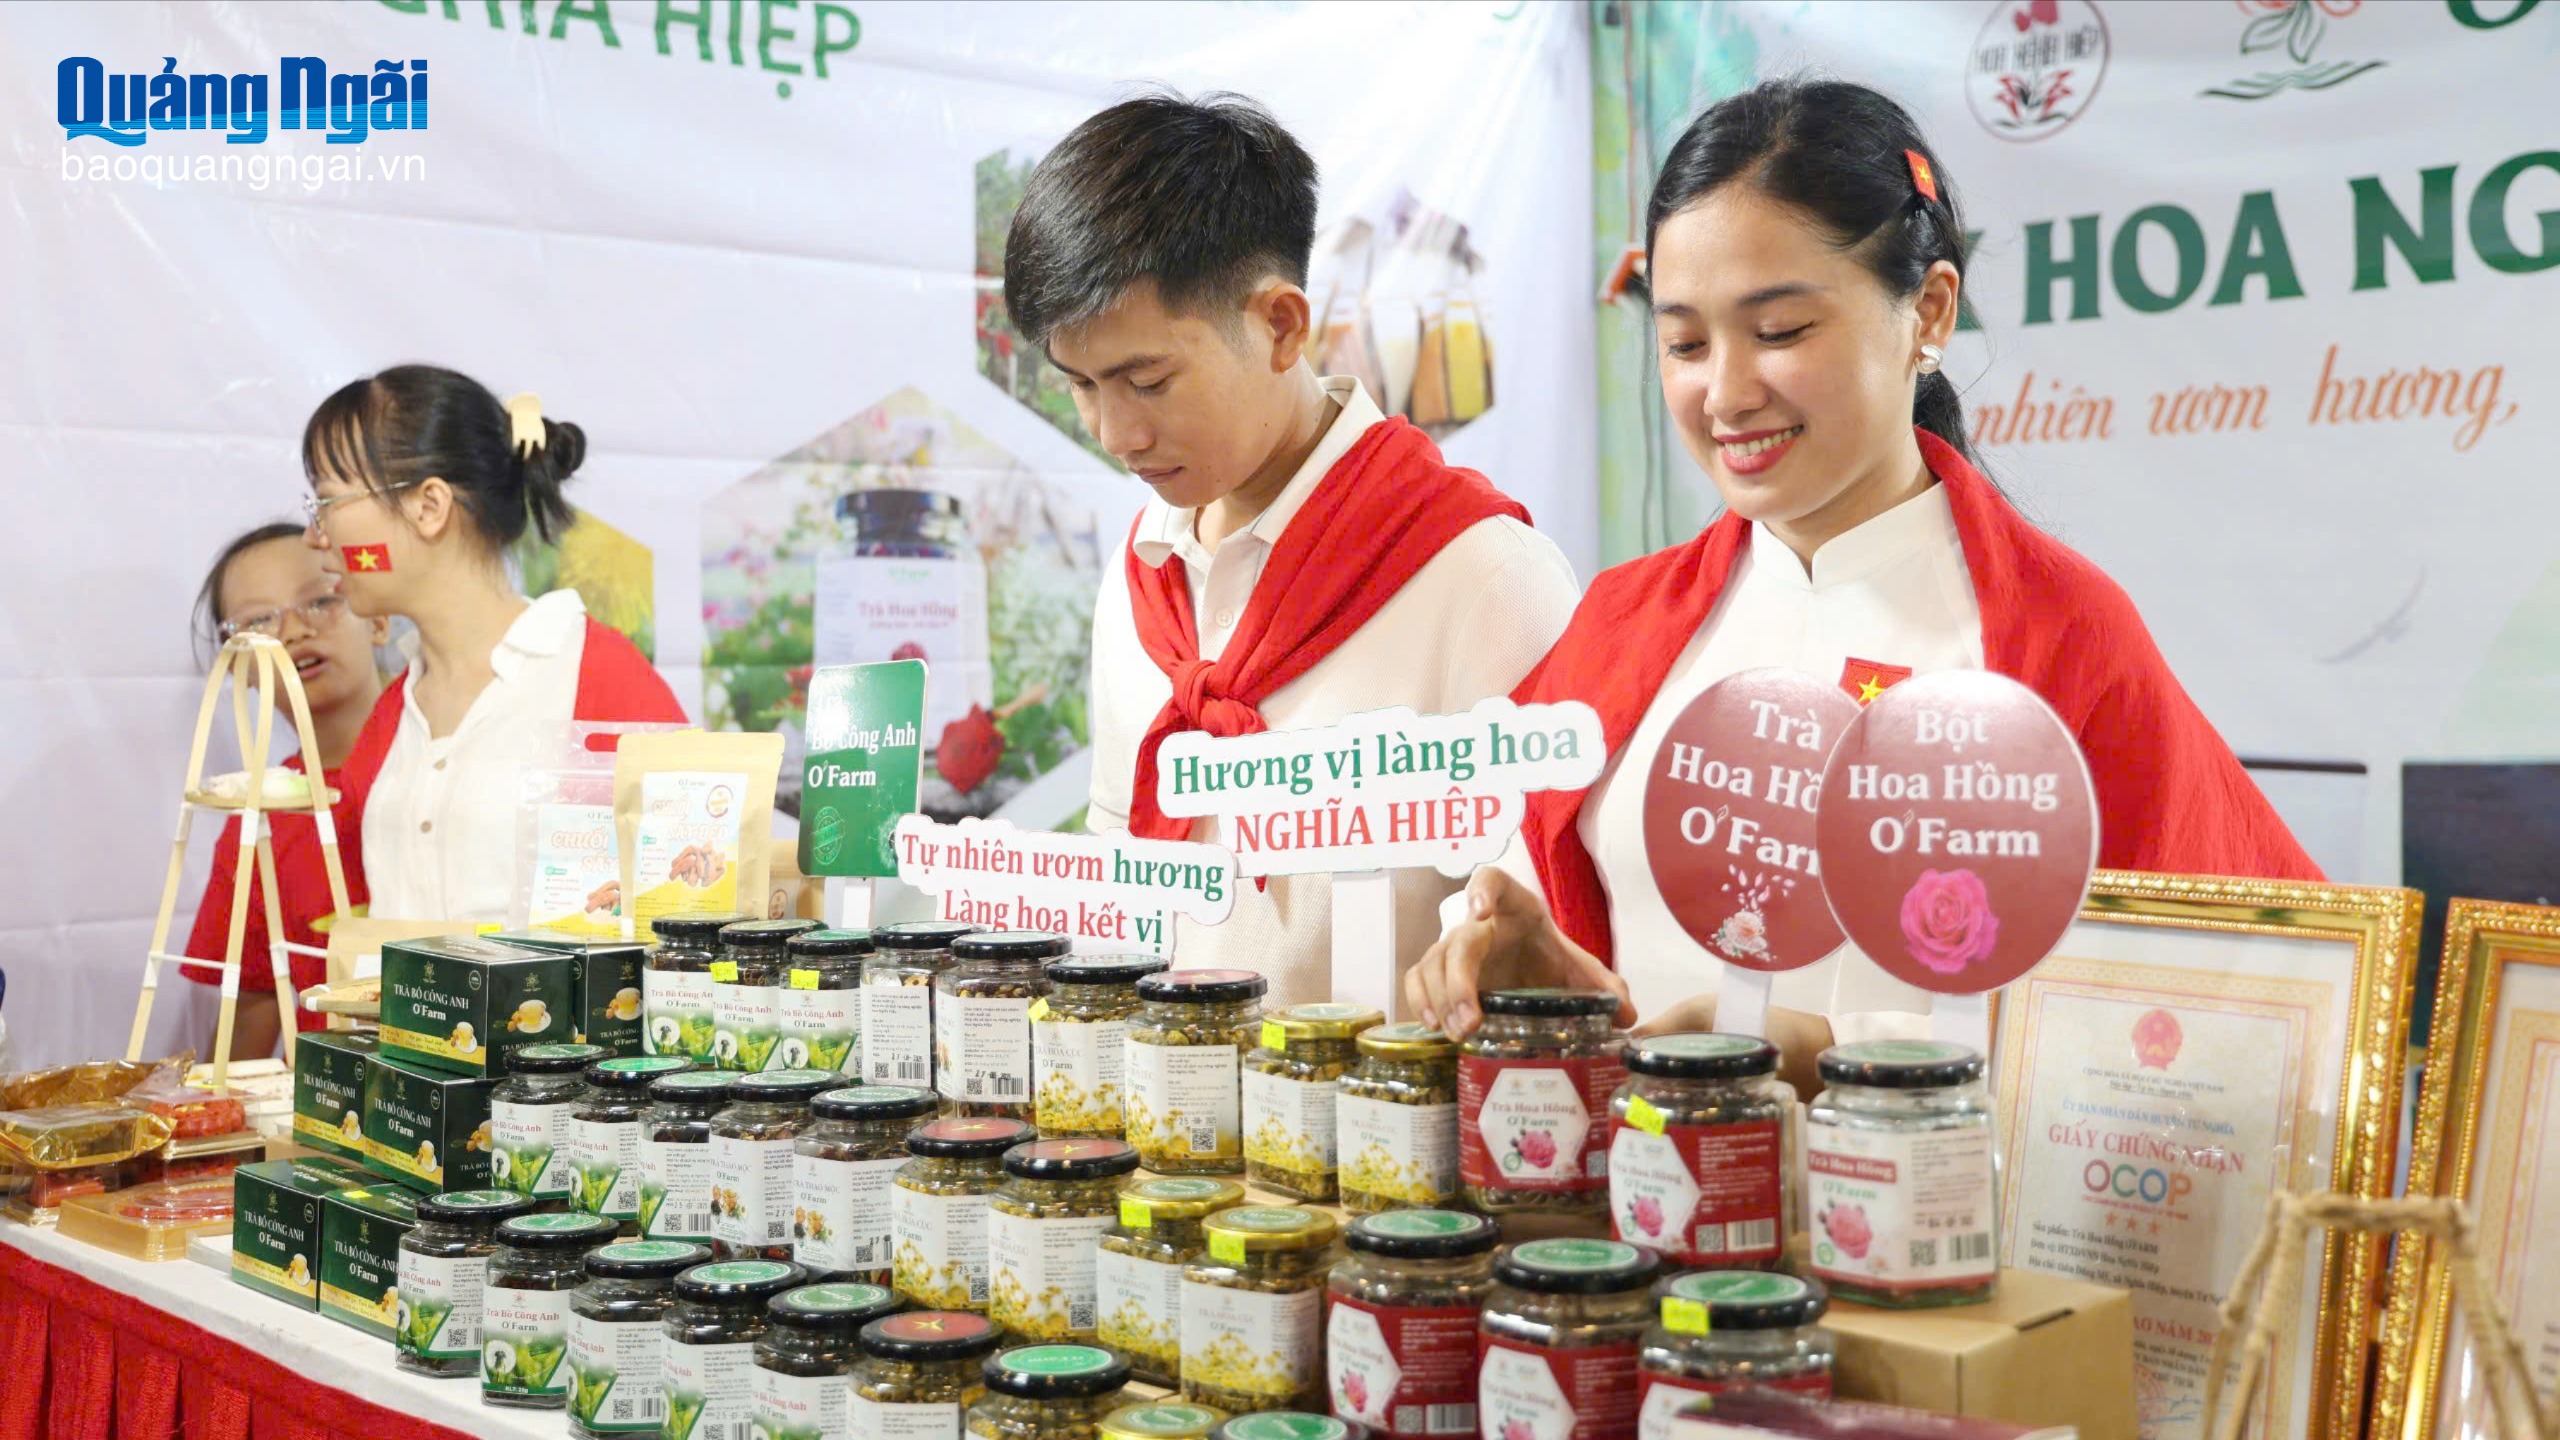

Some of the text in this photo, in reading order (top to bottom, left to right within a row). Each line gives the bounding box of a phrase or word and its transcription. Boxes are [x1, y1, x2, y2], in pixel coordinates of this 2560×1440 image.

[2022, 190, 2307, 326] HOA
[1974, 343, 2519, 454] nhiên ươm hương,
[882, 720, 917, 748] Anh
[1749, 699, 1822, 752] Trà
[1915, 709, 1990, 754] Bột
[1172, 722, 1581, 797] Hương vị làng hoa
[1667, 742, 1754, 799] Hoa
[1847, 760, 2059, 814] Hoa Hồng
[1235, 785, 1503, 855] NGHĨA HIỆP
[902, 833, 1225, 902] Tự nhiên ươm hương
[944, 889, 1164, 954] Làng hoa kết vị
[394, 983, 410, 998] TRÀ
[423, 988, 448, 1006] CÔNG
[449, 997, 470, 1010] ANH
[826, 1009, 845, 1019] Anh
[303, 1073, 314, 1087] TRÀ
[324, 1078, 341, 1094] CÔNG
[341, 1086, 356, 1099] ANH
[374, 1097, 387, 1112] TRÀ
[397, 1105, 416, 1121] CÔNG
[416, 1115, 432, 1129] ANH
[2048, 1119, 2098, 1150] GIẤY
[2103, 1130, 2178, 1164] CHỨNG
[2082, 1158, 2193, 1207] OCOP
[244, 1210, 258, 1226] TRÀ
[267, 1215, 288, 1235] CÔNG
[288, 1227, 305, 1242] ANH
[334, 1240, 349, 1256] TRÀ
[359, 1246, 380, 1267] CÔNG
[539, 1312, 560, 1322] Anh
